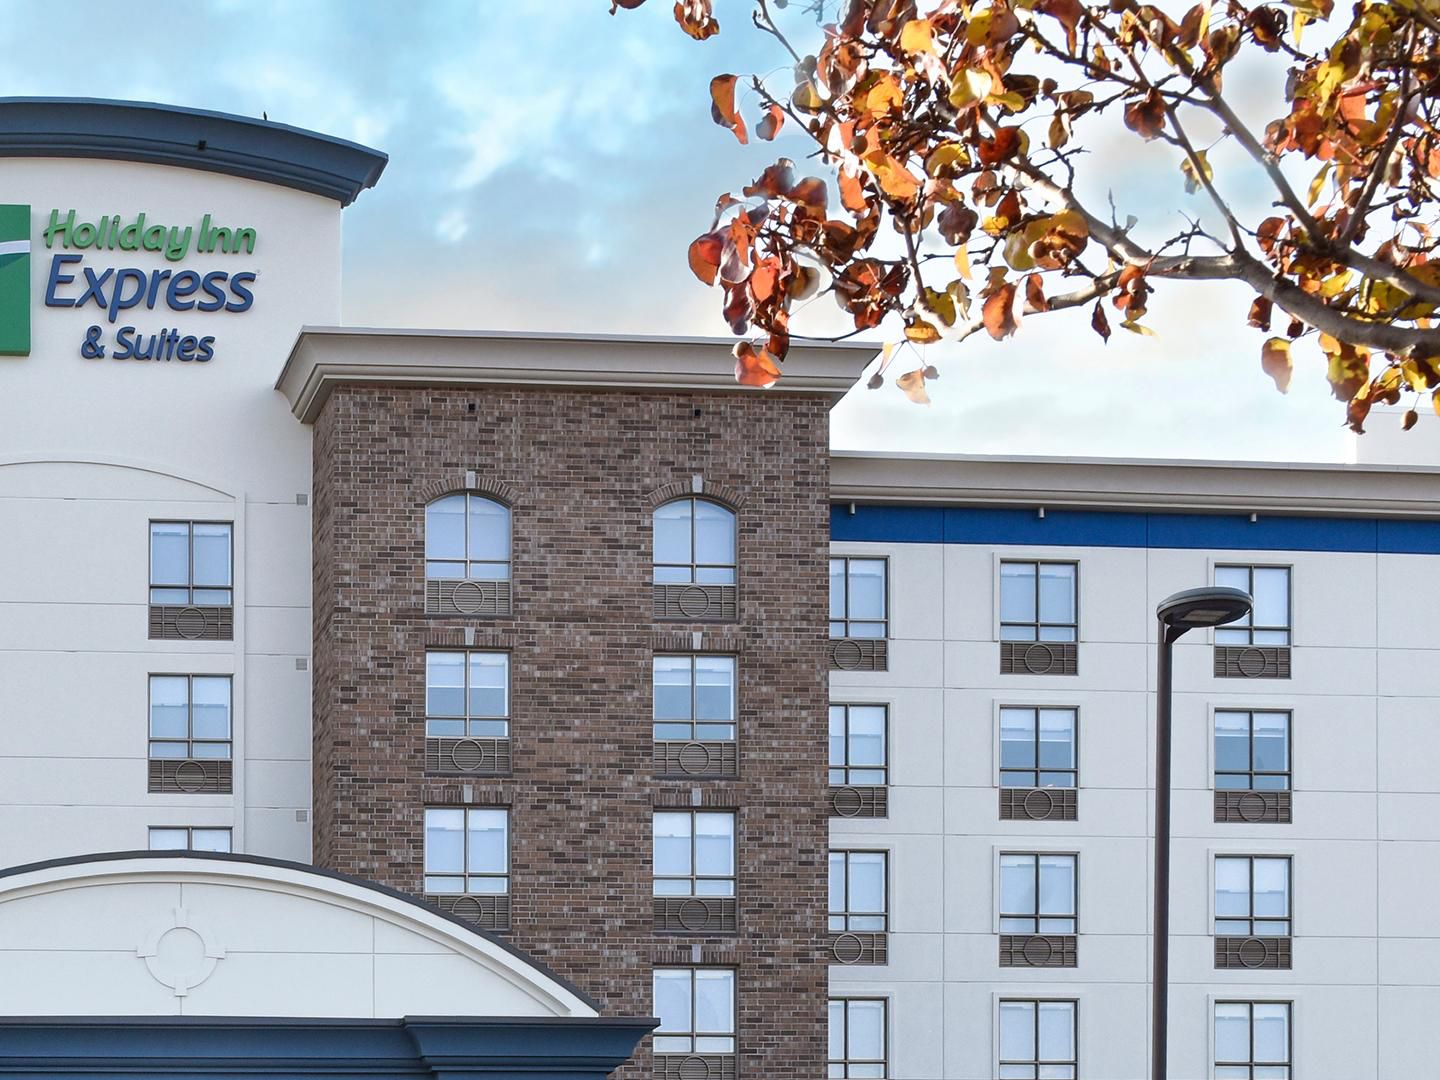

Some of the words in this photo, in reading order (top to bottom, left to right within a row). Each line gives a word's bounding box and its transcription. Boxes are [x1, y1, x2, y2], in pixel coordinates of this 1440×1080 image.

[43, 209, 192, 261] Holiday
[197, 213, 257, 254] Inn
[45, 254, 256, 323] Express
[81, 325, 105, 360] &
[112, 327, 215, 362] Suites
